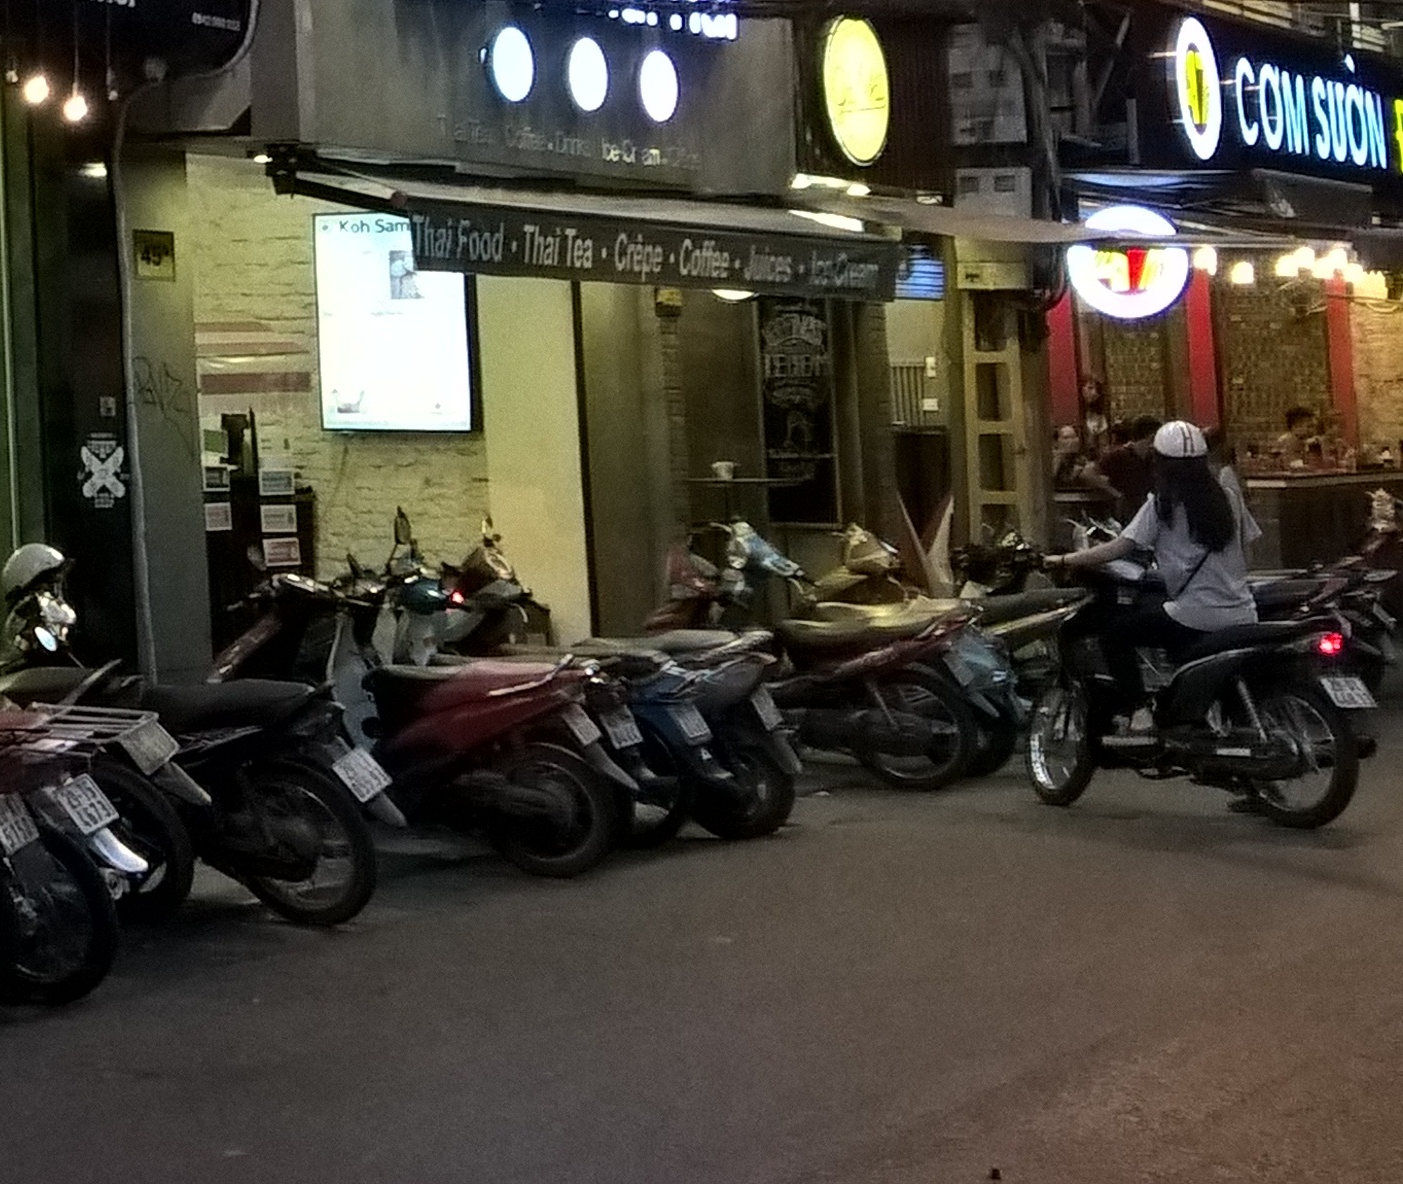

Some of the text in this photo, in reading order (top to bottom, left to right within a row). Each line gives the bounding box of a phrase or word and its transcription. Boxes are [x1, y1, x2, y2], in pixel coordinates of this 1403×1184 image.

[1235, 56, 1311, 156] CƠM
[338, 218, 412, 234] Koh Sam
[412, 214, 453, 259] Thai
[456, 218, 505, 263] Food
[522, 223, 562, 267] Thai
[564, 227, 594, 269] Tea
[614, 232, 664, 282] Crêpe
[678, 238, 731, 279] Coffee
